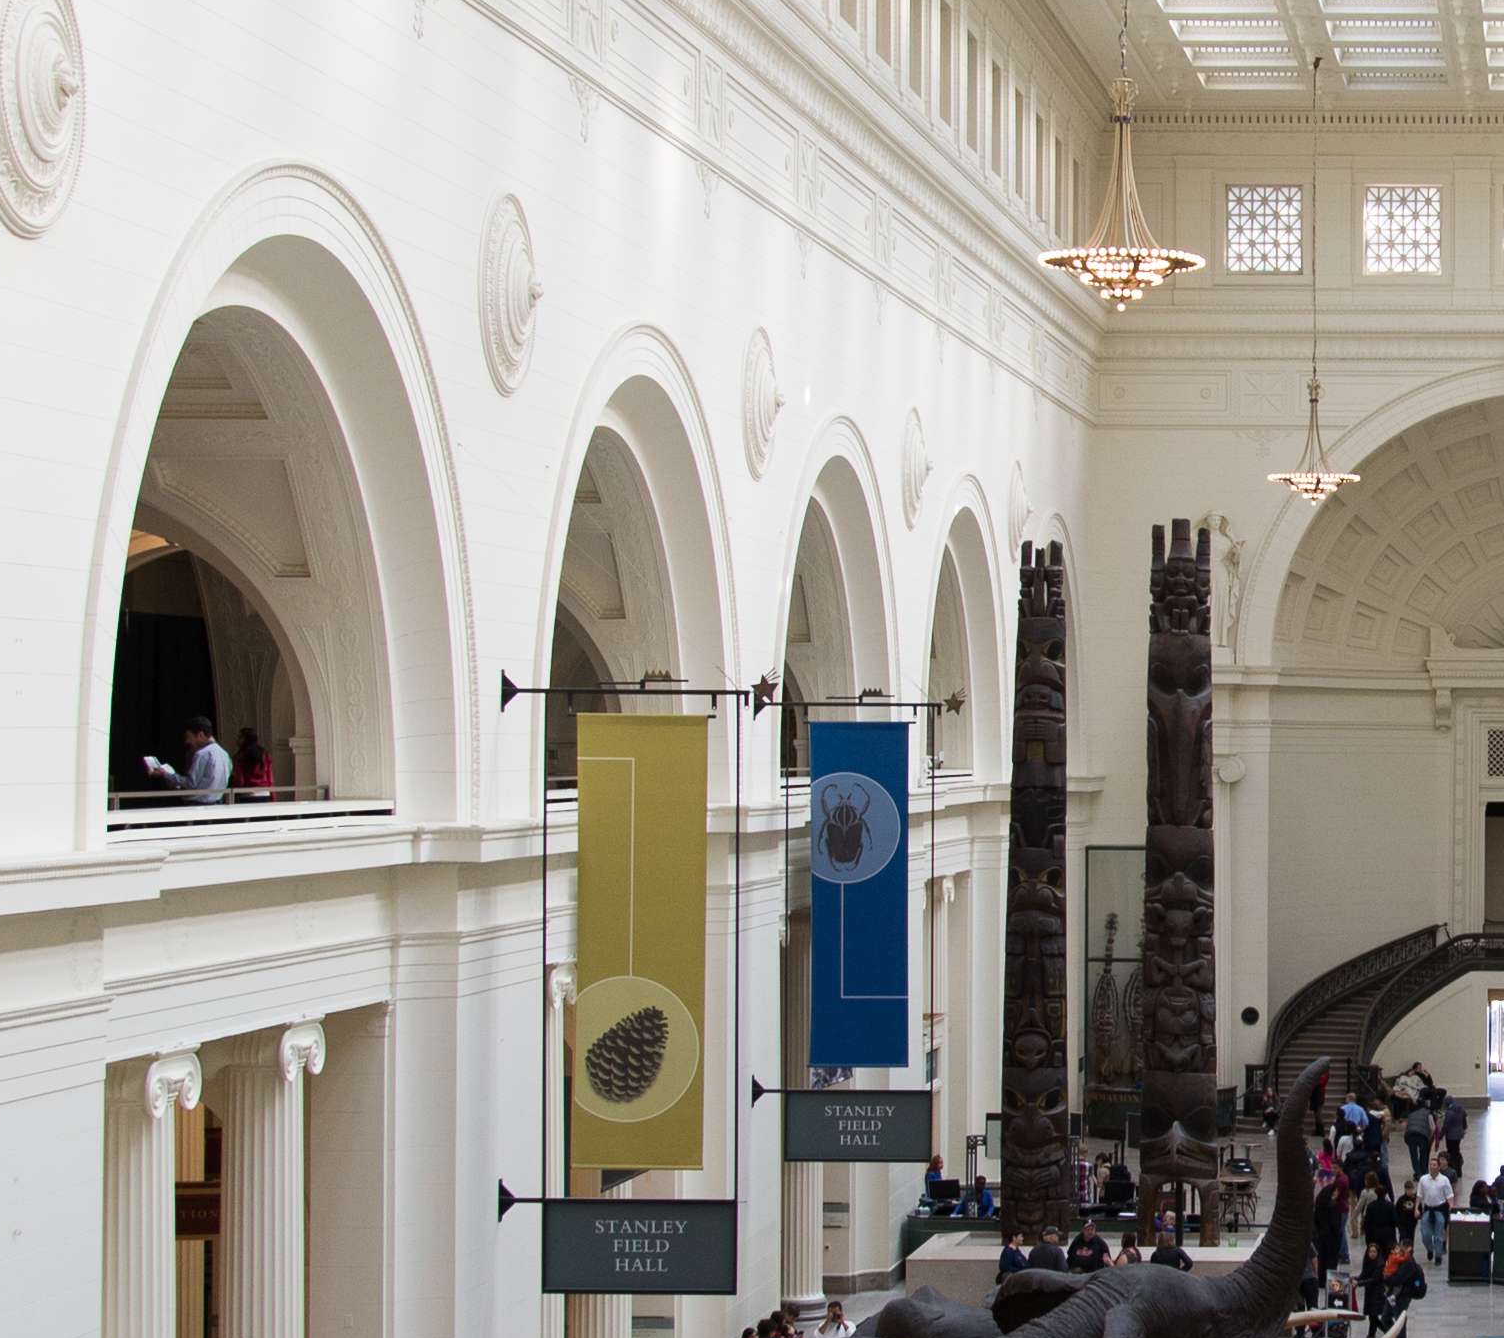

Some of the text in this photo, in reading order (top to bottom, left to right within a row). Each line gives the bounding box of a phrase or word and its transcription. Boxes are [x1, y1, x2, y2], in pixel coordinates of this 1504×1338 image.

[825, 1105, 896, 1117] STANLEY
[838, 1120, 882, 1131] FIELD
[840, 1135, 880, 1146] HALL
[595, 1220, 688, 1234] STANLEY
[613, 1239, 670, 1253] FIELD
[615, 1258, 668, 1272] HALL
